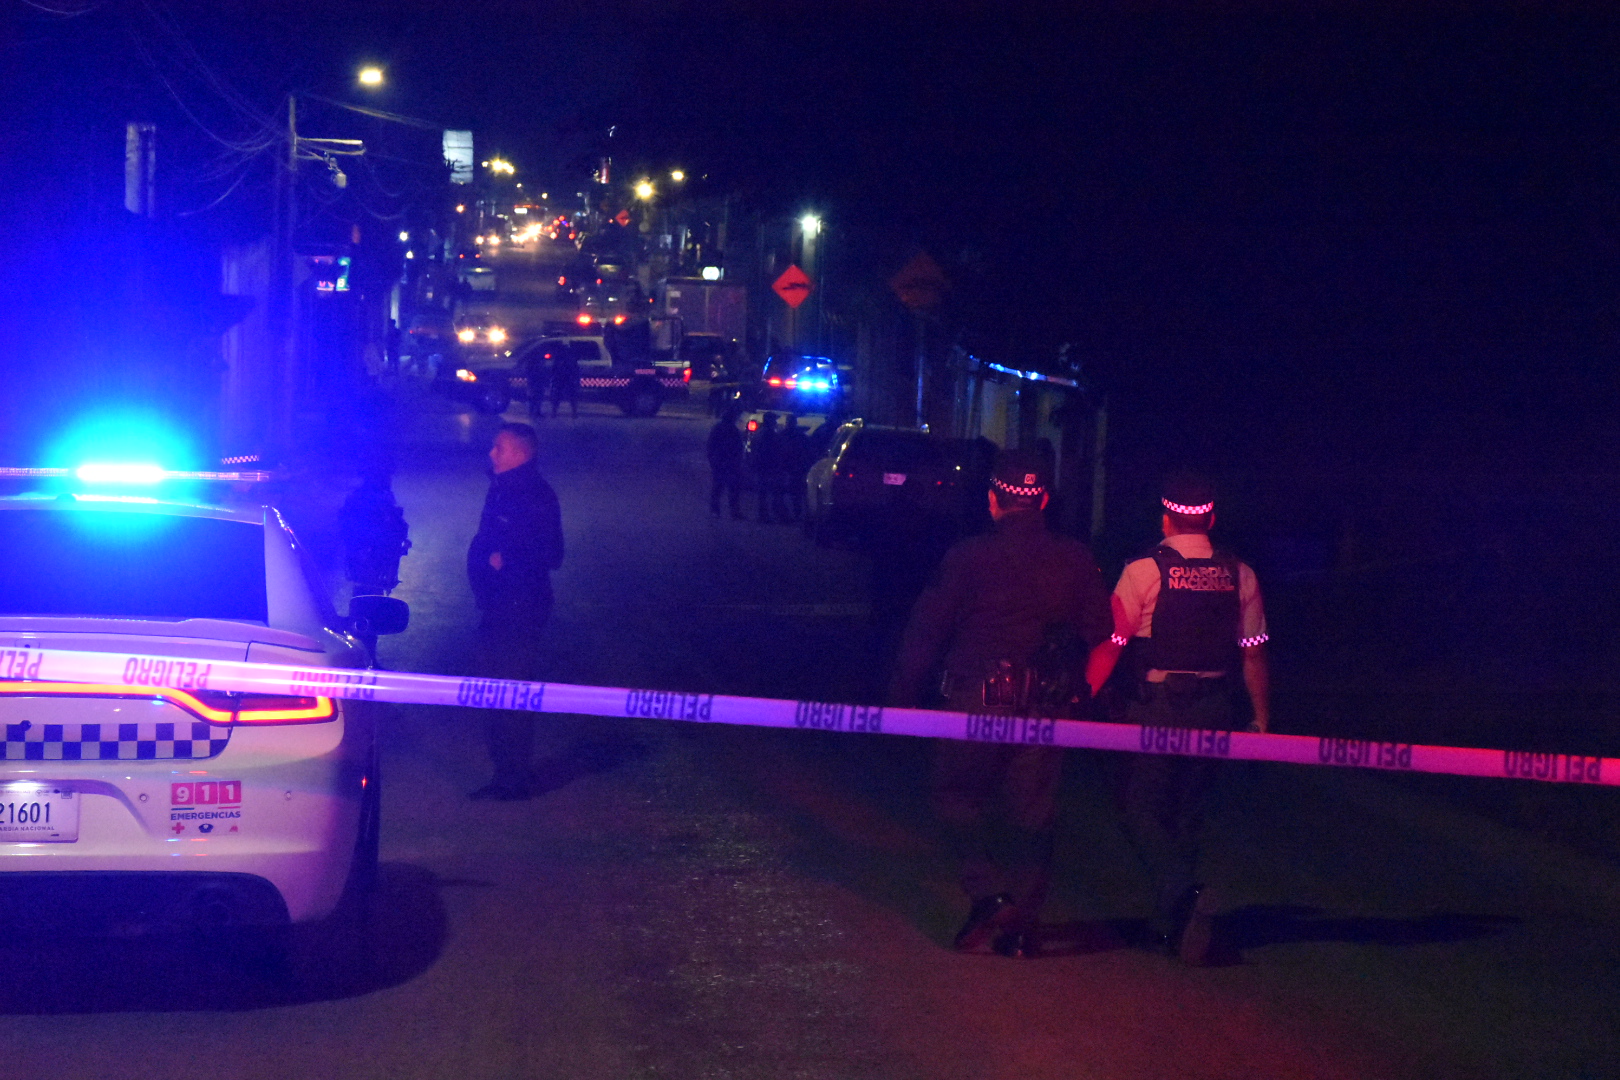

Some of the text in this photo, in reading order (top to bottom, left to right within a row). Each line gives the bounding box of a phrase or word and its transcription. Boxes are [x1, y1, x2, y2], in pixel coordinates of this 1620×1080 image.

[1169, 566, 1232, 578] GUARDIA
[1169, 577, 1235, 591] NACIONAL
[122, 657, 211, 689] PELIGRO
[290, 670, 376, 699] PELIGRO
[457, 676, 543, 709] PELIGRO
[626, 689, 711, 720] PELIGRO
[796, 700, 881, 730] PELIGRO
[966, 713, 1054, 743] PELIGRO
[1140, 725, 1229, 754] PELIGRO
[1319, 738, 1411, 768] PELIGRO
[1504, 751, 1600, 780] PELIGRO
[176, 784, 234, 802] 911
[171, 811, 241, 820] EMERGENCIAS
